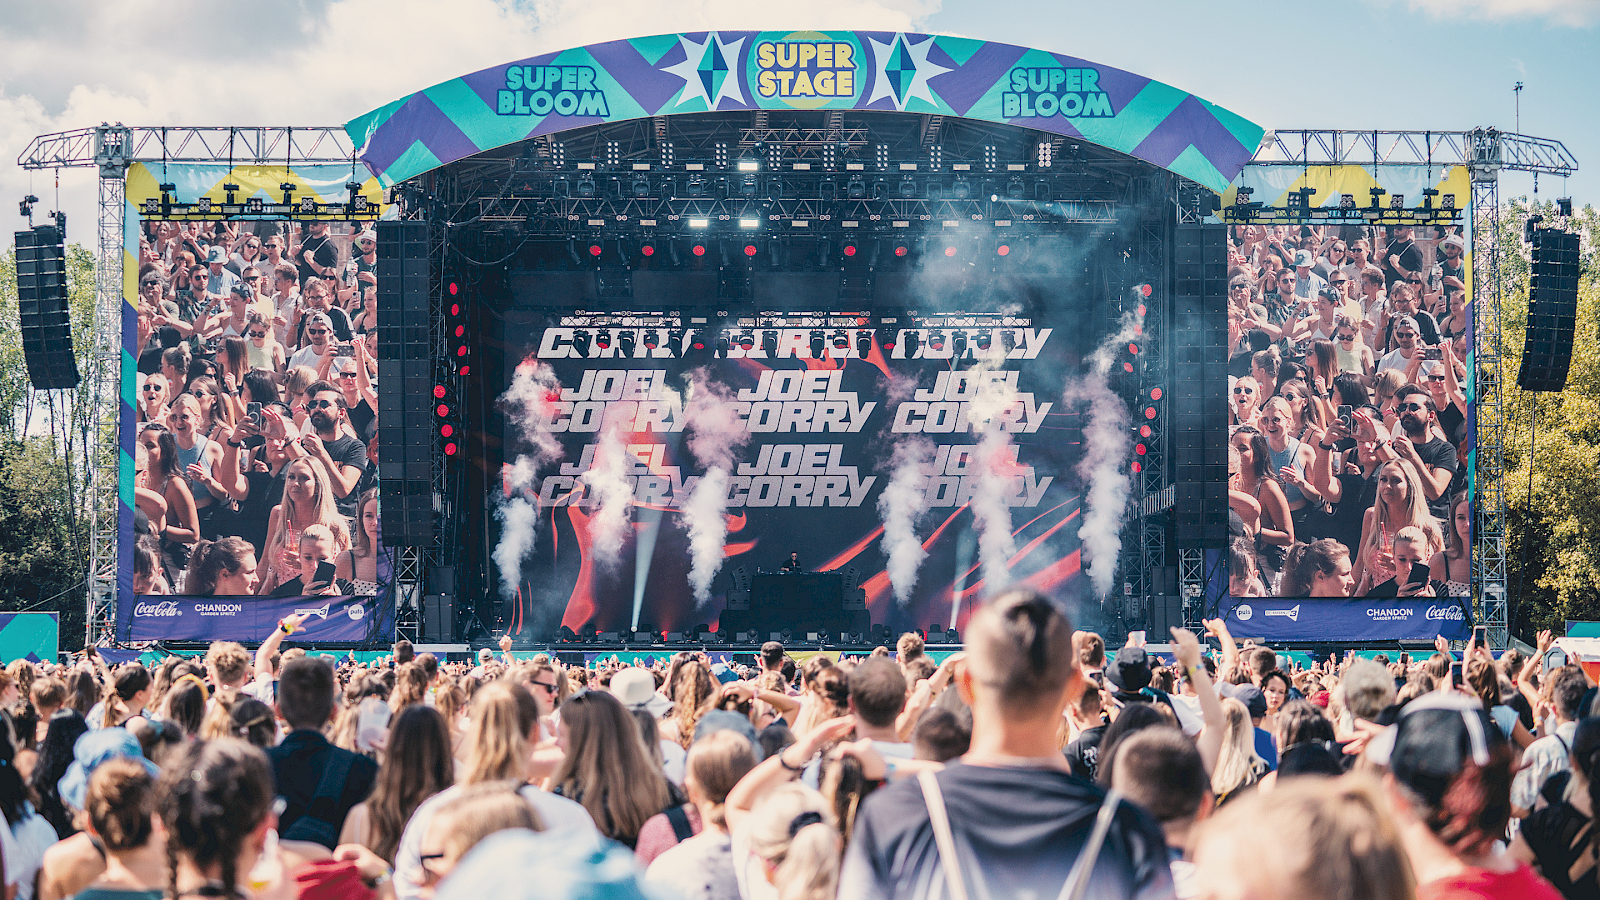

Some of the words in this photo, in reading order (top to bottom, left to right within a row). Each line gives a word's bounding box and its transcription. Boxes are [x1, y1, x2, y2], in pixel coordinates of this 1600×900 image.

[757, 42, 856, 68] SUPER
[505, 64, 598, 90] SUPER
[757, 69, 854, 97] STAGE
[1009, 67, 1101, 92] SUPER
[496, 88, 610, 117] BLOOM
[1001, 89, 1115, 119] BLOOM
[560, 369, 680, 401] JOEL
[737, 369, 858, 401] JOEL
[914, 370, 1034, 402] JOEL
[718, 401, 877, 433] CORRY
[559, 443, 680, 475] JEL
[736, 443, 858, 475] JOEL
[916, 444, 1035, 476] JOL
[538, 475, 699, 507] CORY
[721, 475, 877, 507] CORRY
[900, 475, 1054, 507] ORY
[194, 604, 242, 612] CHANDON
[319, 608, 328, 616] 3
[1366, 608, 1414, 616] CHANDON
[1425, 605, 1463, 621] Coca-Cola
